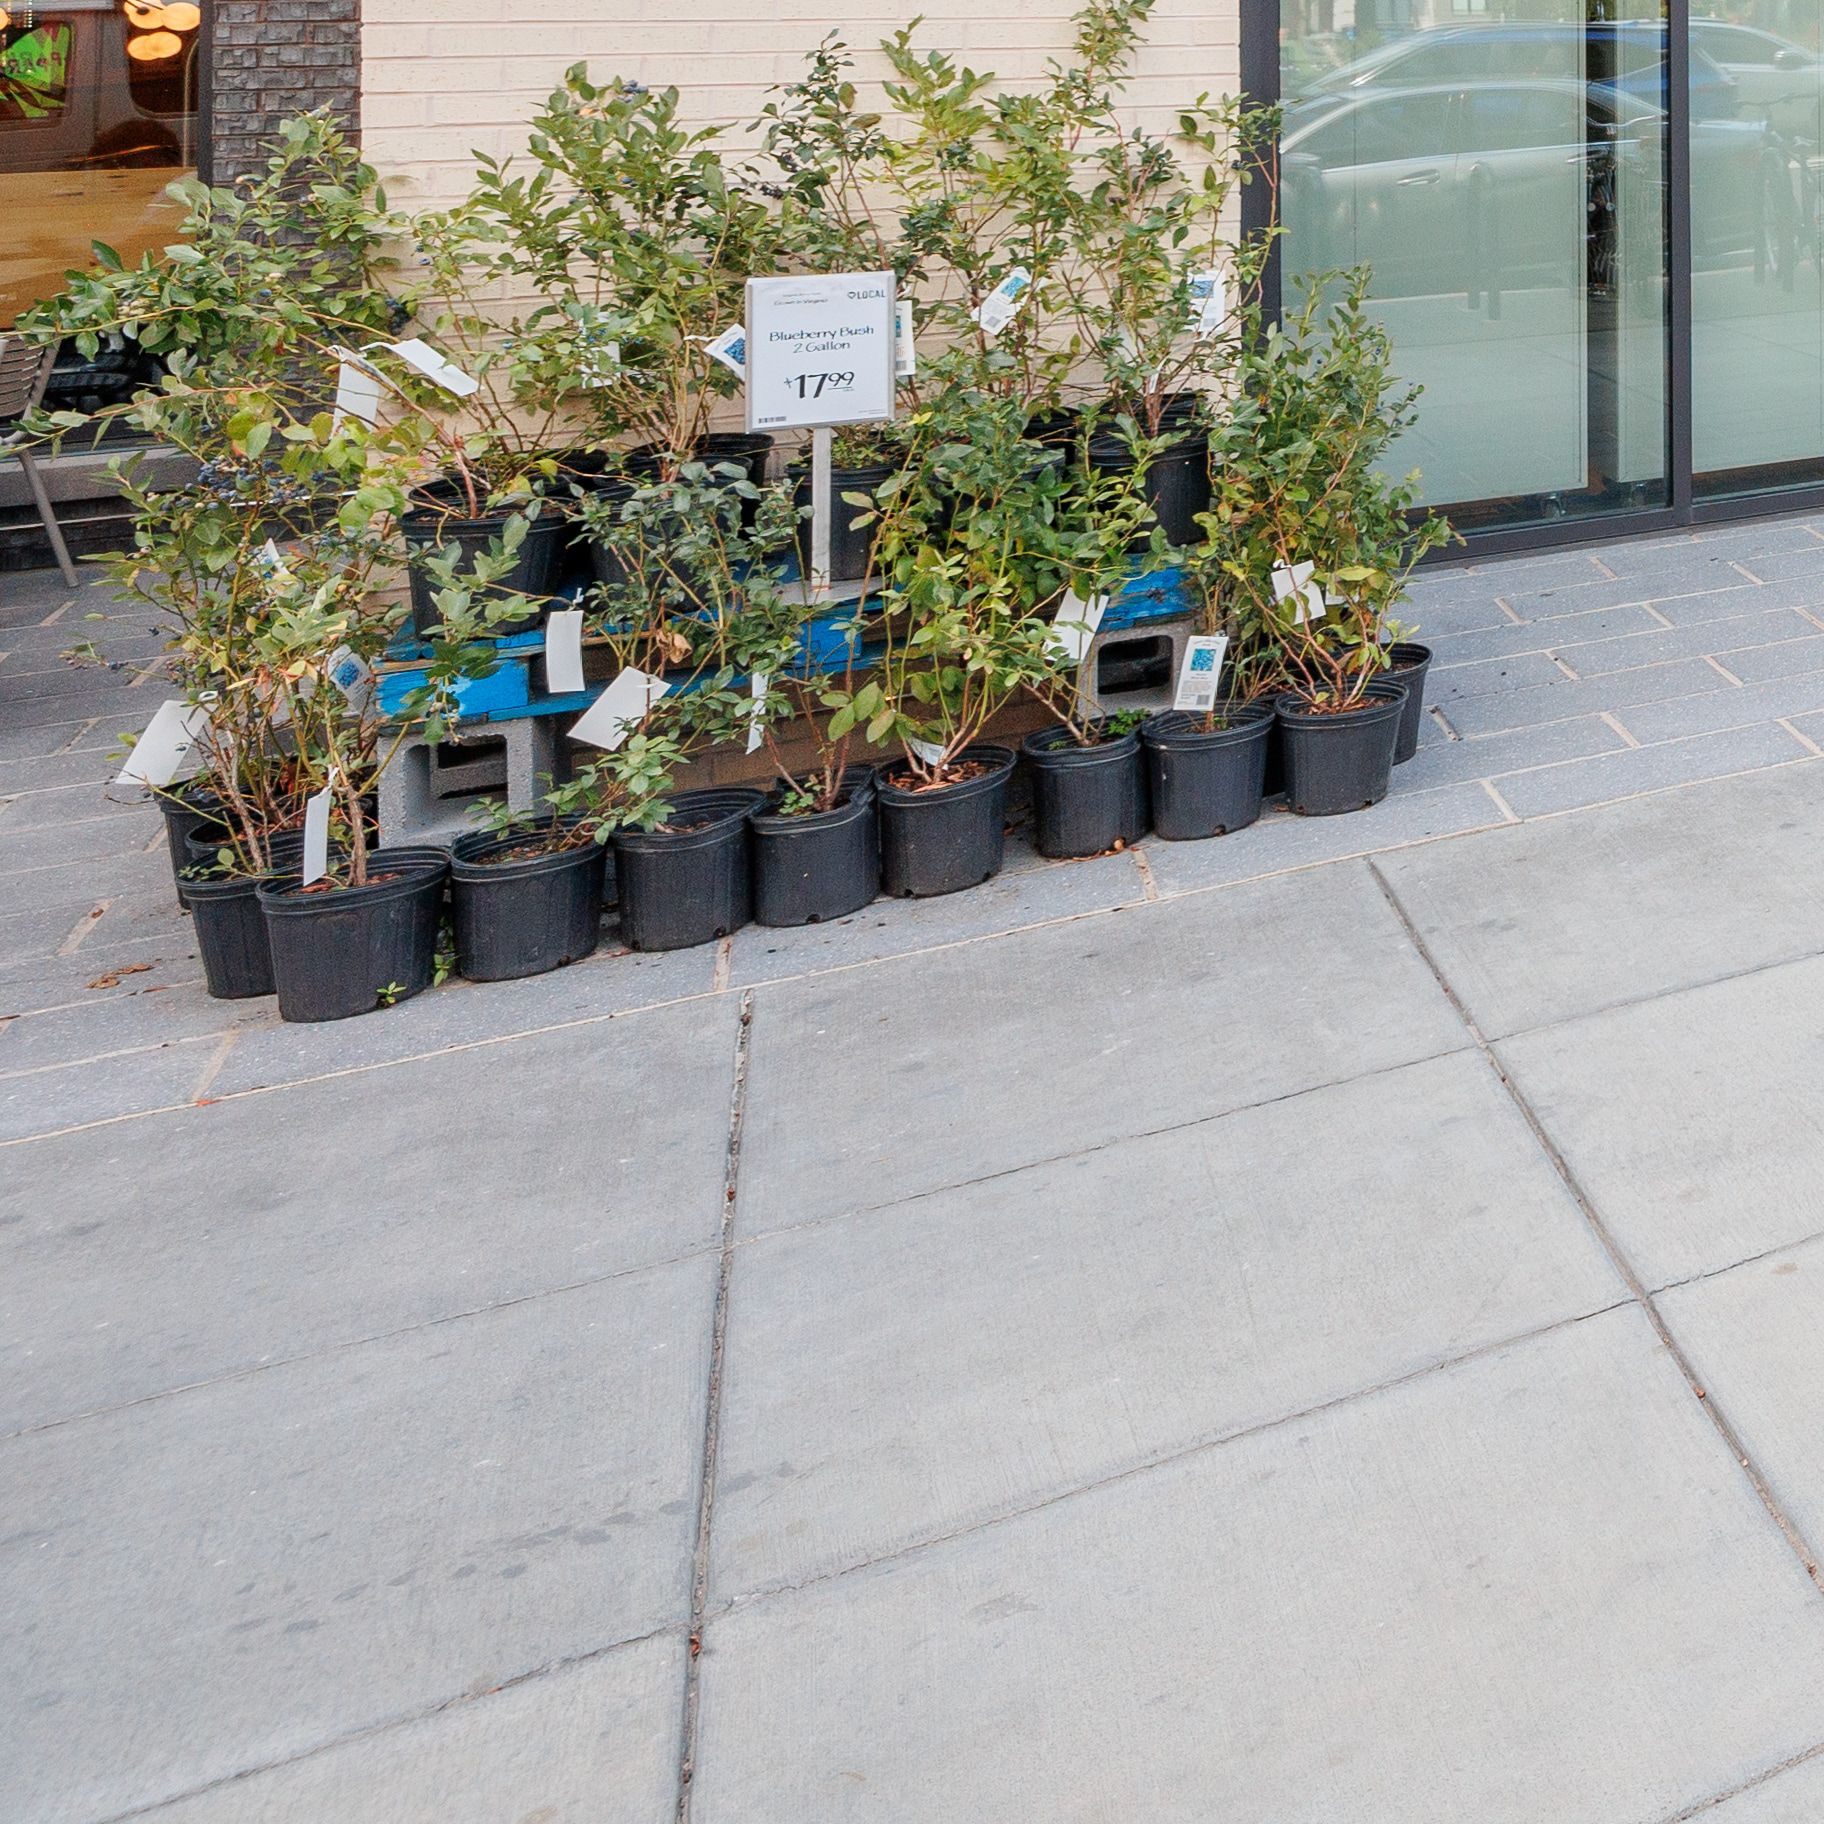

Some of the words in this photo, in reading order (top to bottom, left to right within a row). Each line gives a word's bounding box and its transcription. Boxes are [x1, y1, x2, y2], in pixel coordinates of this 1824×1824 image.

[857, 289, 885, 300] LOCAL
[769, 329, 837, 342] Blueberry
[840, 325, 874, 337] Bush
[793, 343, 803, 354] 2
[805, 340, 850, 353] Gallon
